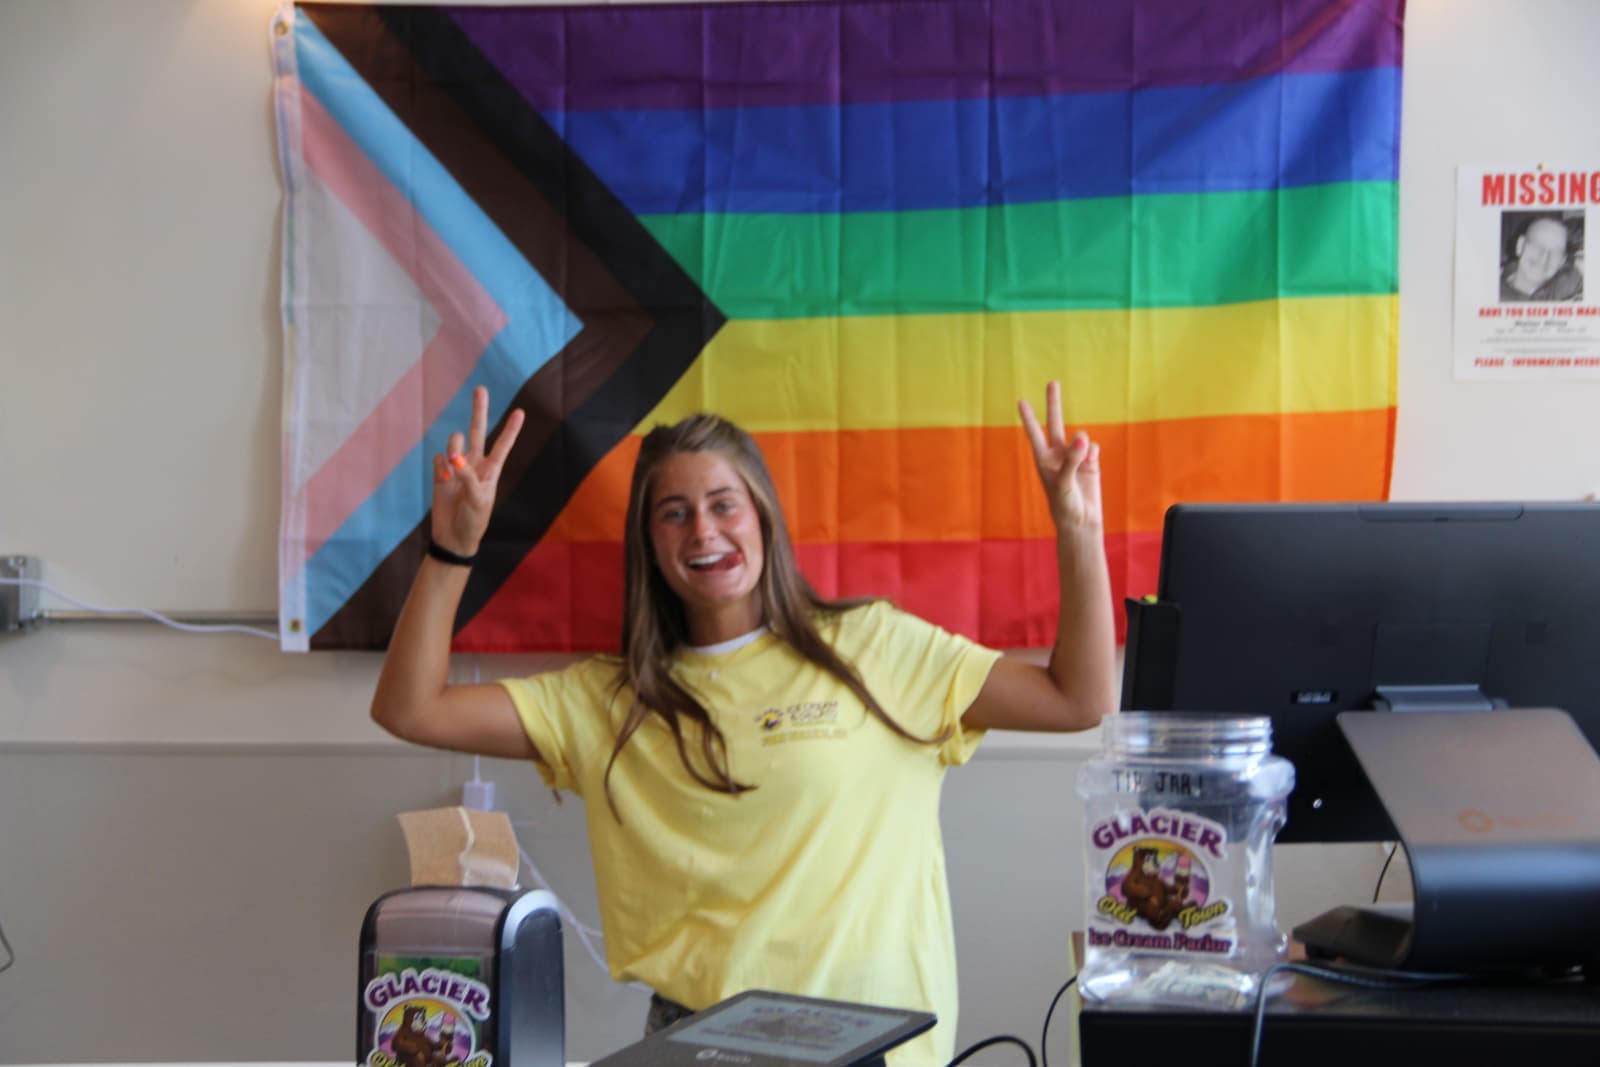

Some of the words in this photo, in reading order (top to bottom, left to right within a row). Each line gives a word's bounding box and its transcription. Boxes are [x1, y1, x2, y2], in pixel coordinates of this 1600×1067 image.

[1482, 172, 1600, 205] MISSING
[1112, 770, 1143, 793] TIP
[1092, 815, 1224, 860] GLACIER
[1098, 896, 1138, 925] Old
[1178, 900, 1228, 929] Town
[1088, 927, 1112, 946] Ice
[1113, 928, 1172, 950] Cream
[368, 975, 486, 1017] GLACIER
